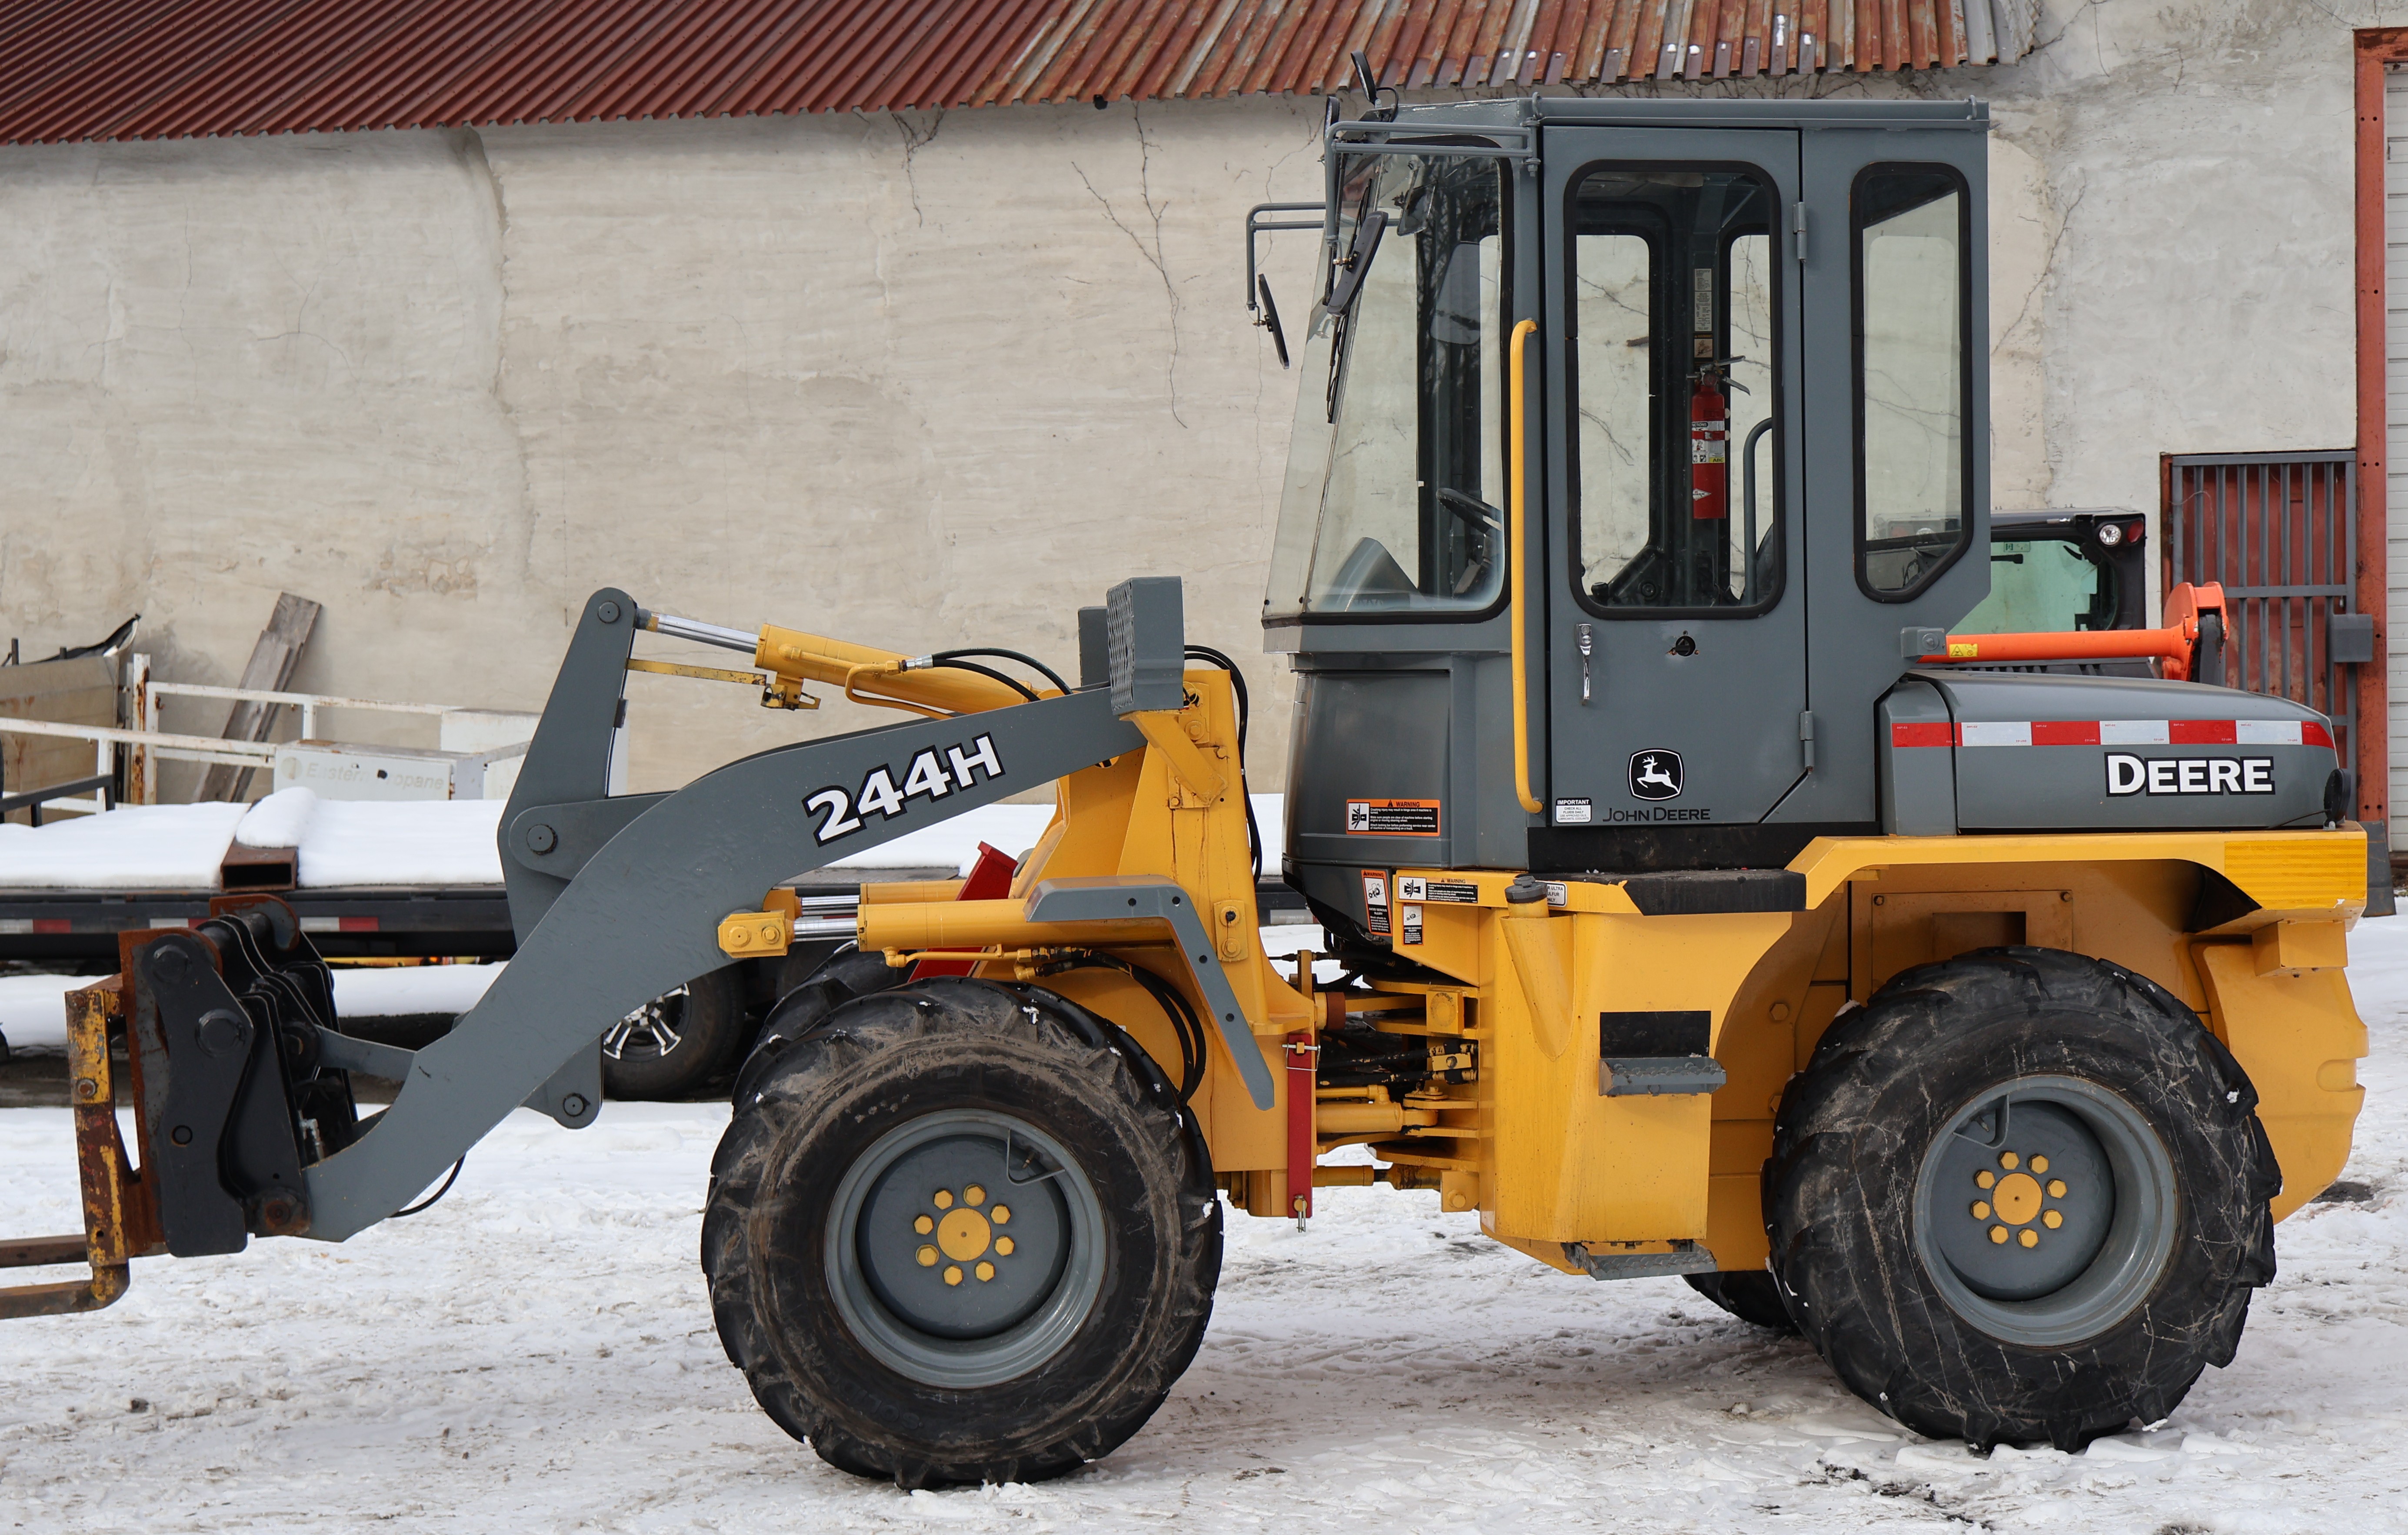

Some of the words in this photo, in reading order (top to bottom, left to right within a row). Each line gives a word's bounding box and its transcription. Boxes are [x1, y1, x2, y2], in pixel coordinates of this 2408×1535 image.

[807, 736, 1002, 841] 244H
[2107, 754, 2273, 794] DEERE
[1603, 808, 1649, 821] JOHN
[1654, 807, 1710, 821] DEERE
